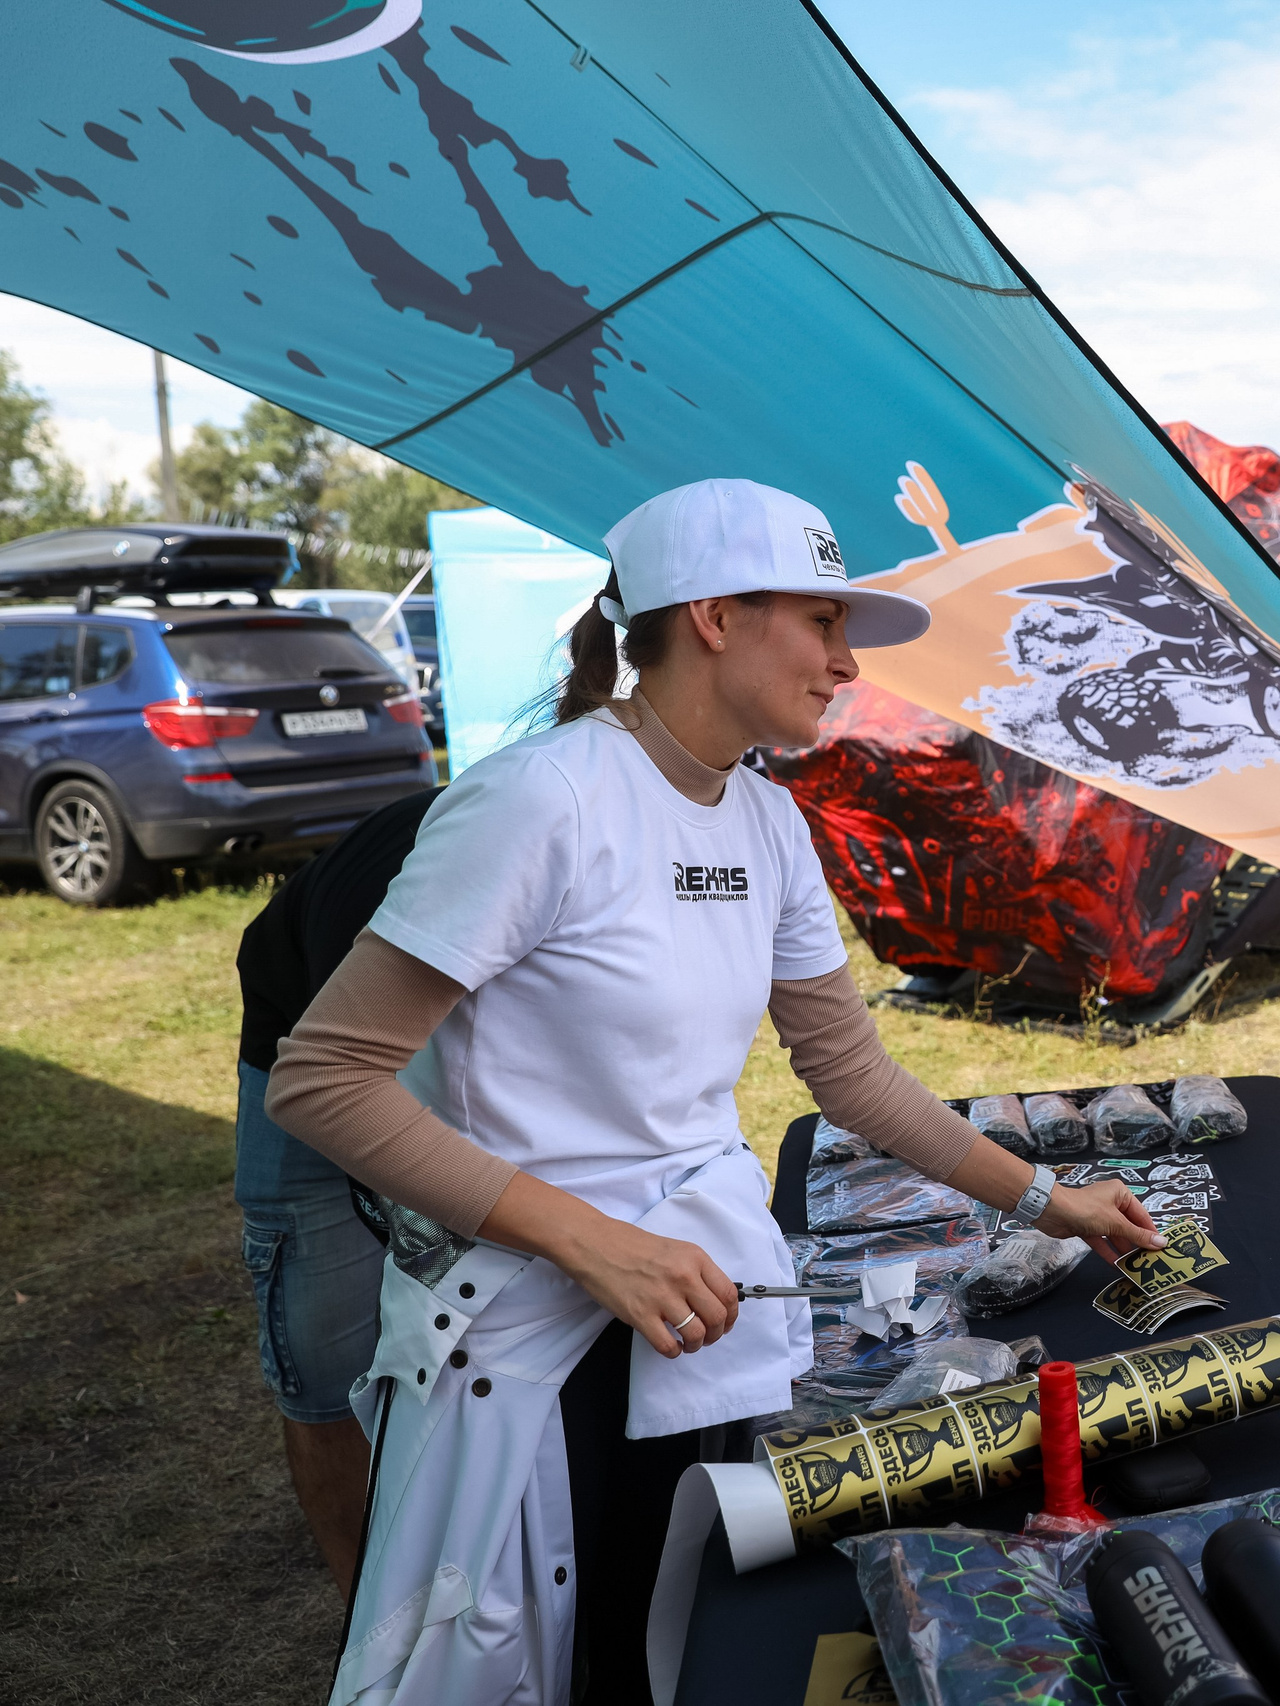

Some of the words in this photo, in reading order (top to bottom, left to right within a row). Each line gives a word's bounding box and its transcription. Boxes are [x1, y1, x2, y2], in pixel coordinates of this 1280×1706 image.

[673, 862, 748, 892] REXAS
[1163, 1224, 1197, 1242] ДЕСЬ
[1142, 1270, 1188, 1294] БЫЛ
[962, 1401, 991, 1455] ЗДЕСЬ
[873, 1428, 901, 1487] ЗДЕСЬ
[780, 1457, 808, 1520] ЗДЕСЬ
[1123, 1566, 1211, 1678] REXAS
